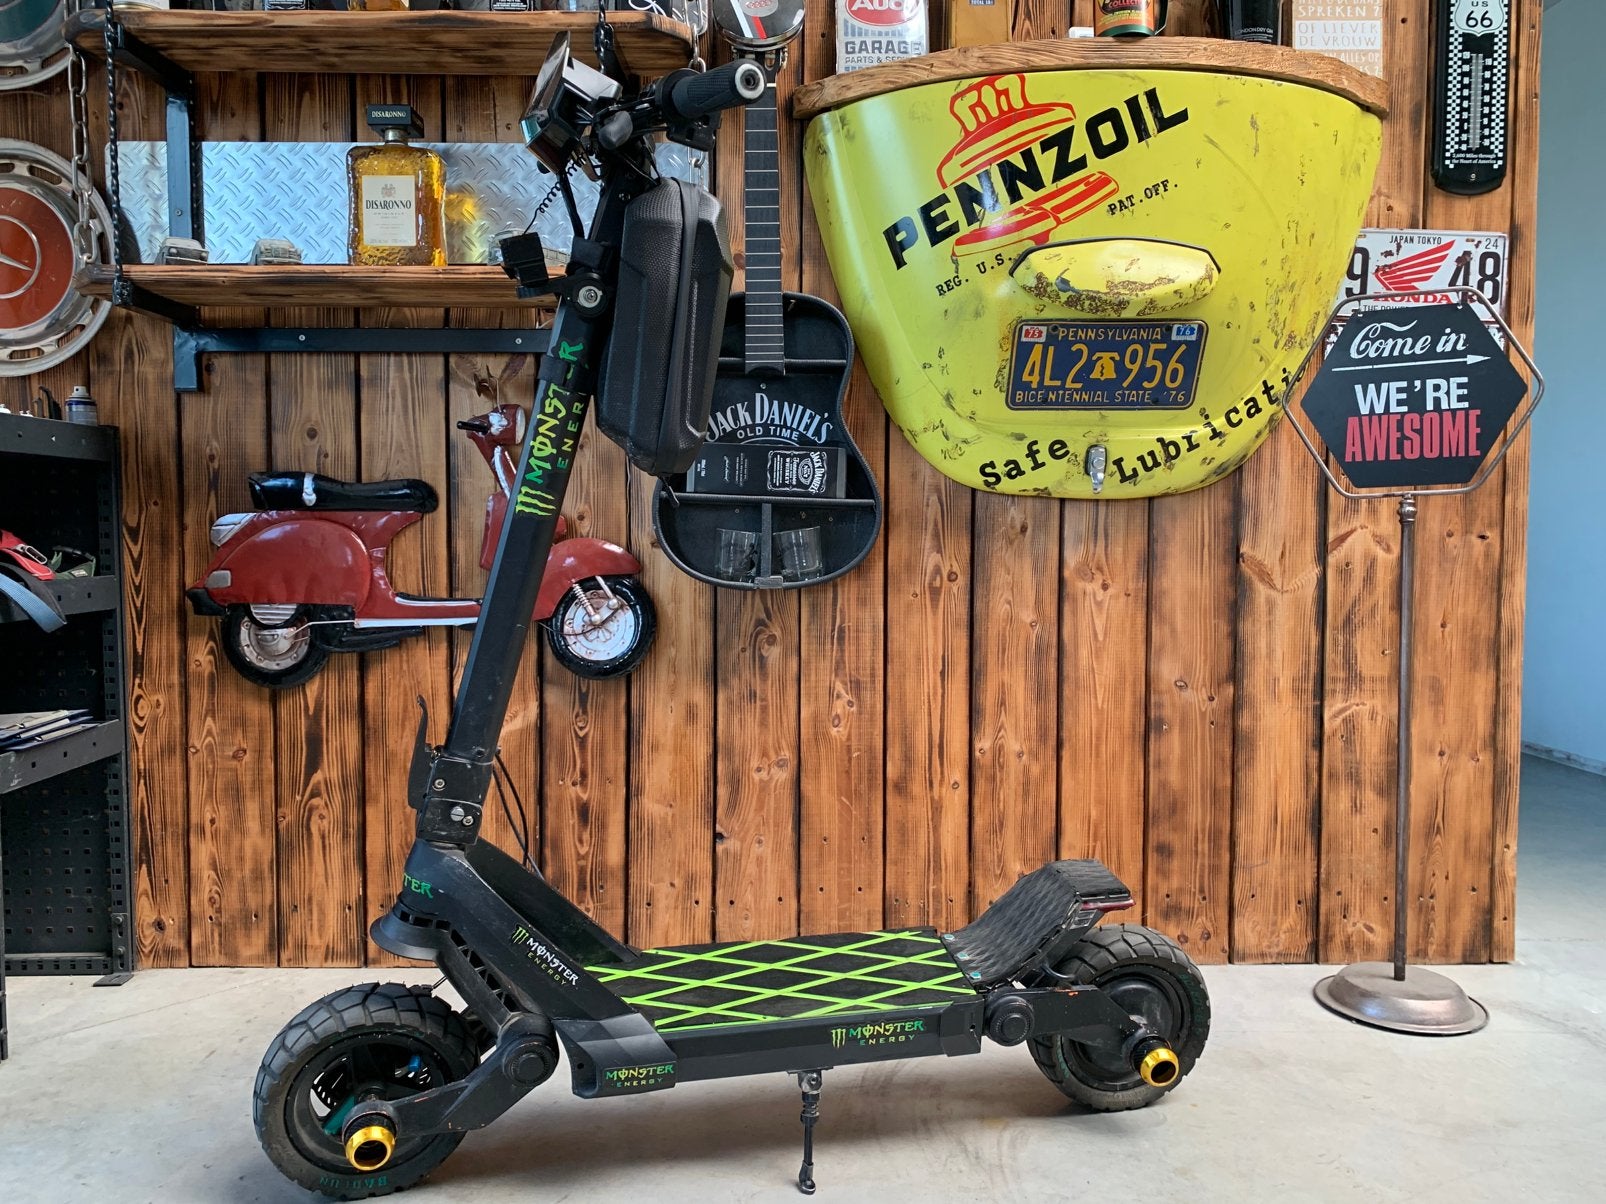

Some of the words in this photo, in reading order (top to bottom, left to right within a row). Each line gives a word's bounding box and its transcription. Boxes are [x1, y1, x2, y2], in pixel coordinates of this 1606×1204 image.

[1298, 5, 1367, 17] SPREKEN
[1465, 10, 1493, 28] 66
[1298, 22, 1316, 34] OF
[1323, 22, 1378, 34] LIEVER
[844, 40, 922, 55] GARAGE
[1299, 35, 1315, 47] DE
[1322, 35, 1377, 47] VROUW
[845, 56, 874, 64] PARTS
[371, 110, 407, 119] DISARONNO
[882, 87, 1189, 271] PENNZOIL
[365, 199, 412, 211] DISARONNO
[1389, 235, 1414, 244] JAPAN
[1417, 236, 1442, 245] TOKYO
[1484, 238, 1499, 250] 24
[935, 275, 969, 297] REG.
[976, 253, 1013, 275] U.S.
[1058, 328, 1162, 341] PENNSYLVANIA
[1350, 320, 1431, 359] Come
[1436, 327, 1469, 353] in
[1022, 343, 1089, 389] 4L2
[1122, 343, 1187, 389] 956
[1114, 390, 1152, 403] STATE
[1354, 376, 1470, 415] WE'RE
[705, 402, 753, 442] JACK
[755, 392, 833, 444] DANIEL'S
[736, 426, 763, 439] OLD
[768, 426, 800, 441] TIME
[1345, 409, 1481, 463] AWESOME
[810, 451, 822, 468] JACK
[978, 438, 1070, 489] Safe
[527, 952, 567, 985] ENERGY
[859, 1034, 915, 1046] ENERGY
[616, 1077, 664, 1088] ENERGY
